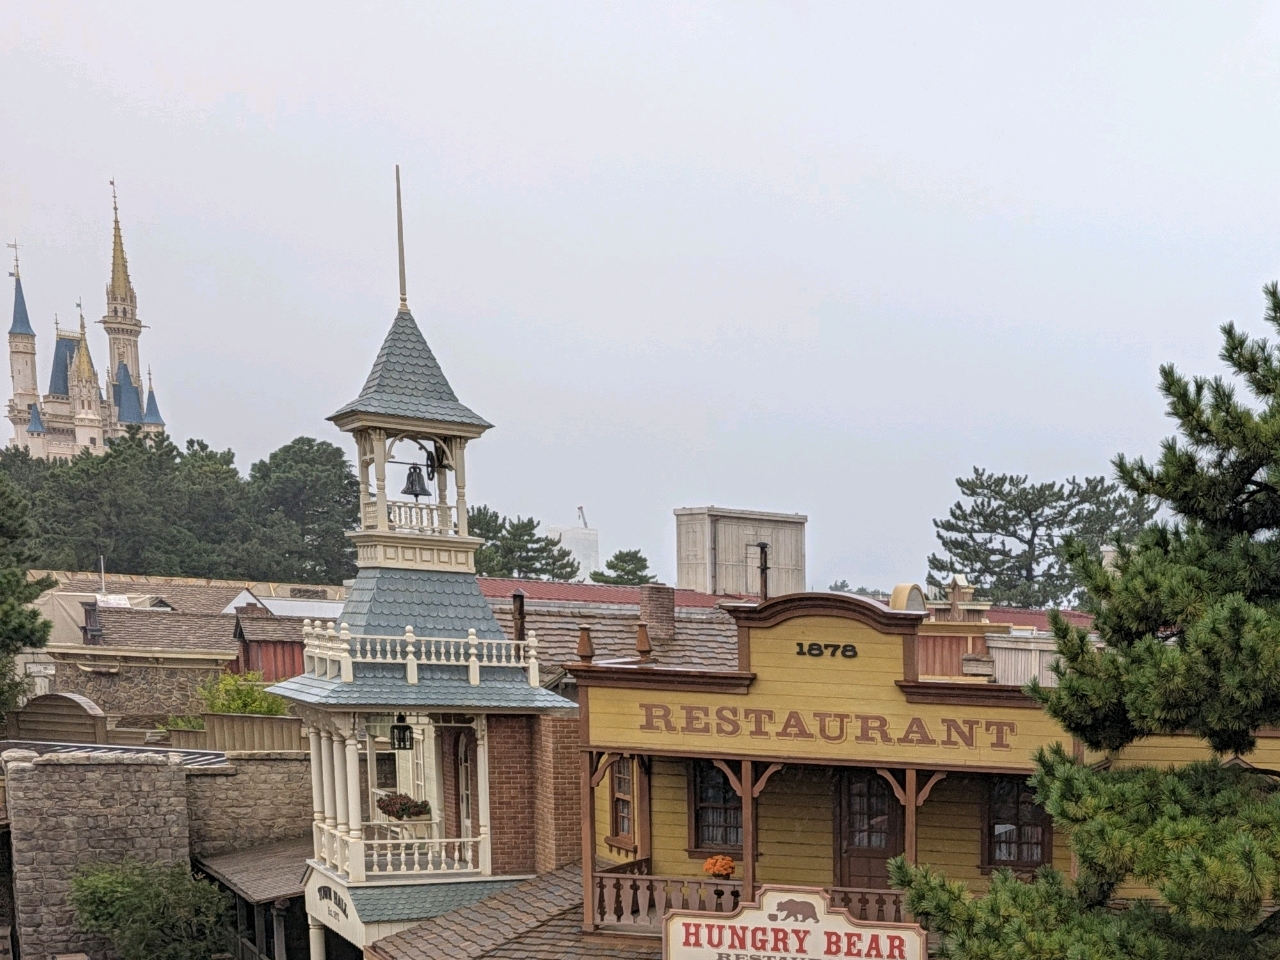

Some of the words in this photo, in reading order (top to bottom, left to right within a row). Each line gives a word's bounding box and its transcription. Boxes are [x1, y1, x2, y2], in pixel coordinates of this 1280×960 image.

[796, 642, 858, 658] 1878
[639, 703, 1017, 751] RESTAURANT
[682, 922, 811, 954] HUNGRY
[824, 931, 907, 960] BEAR
